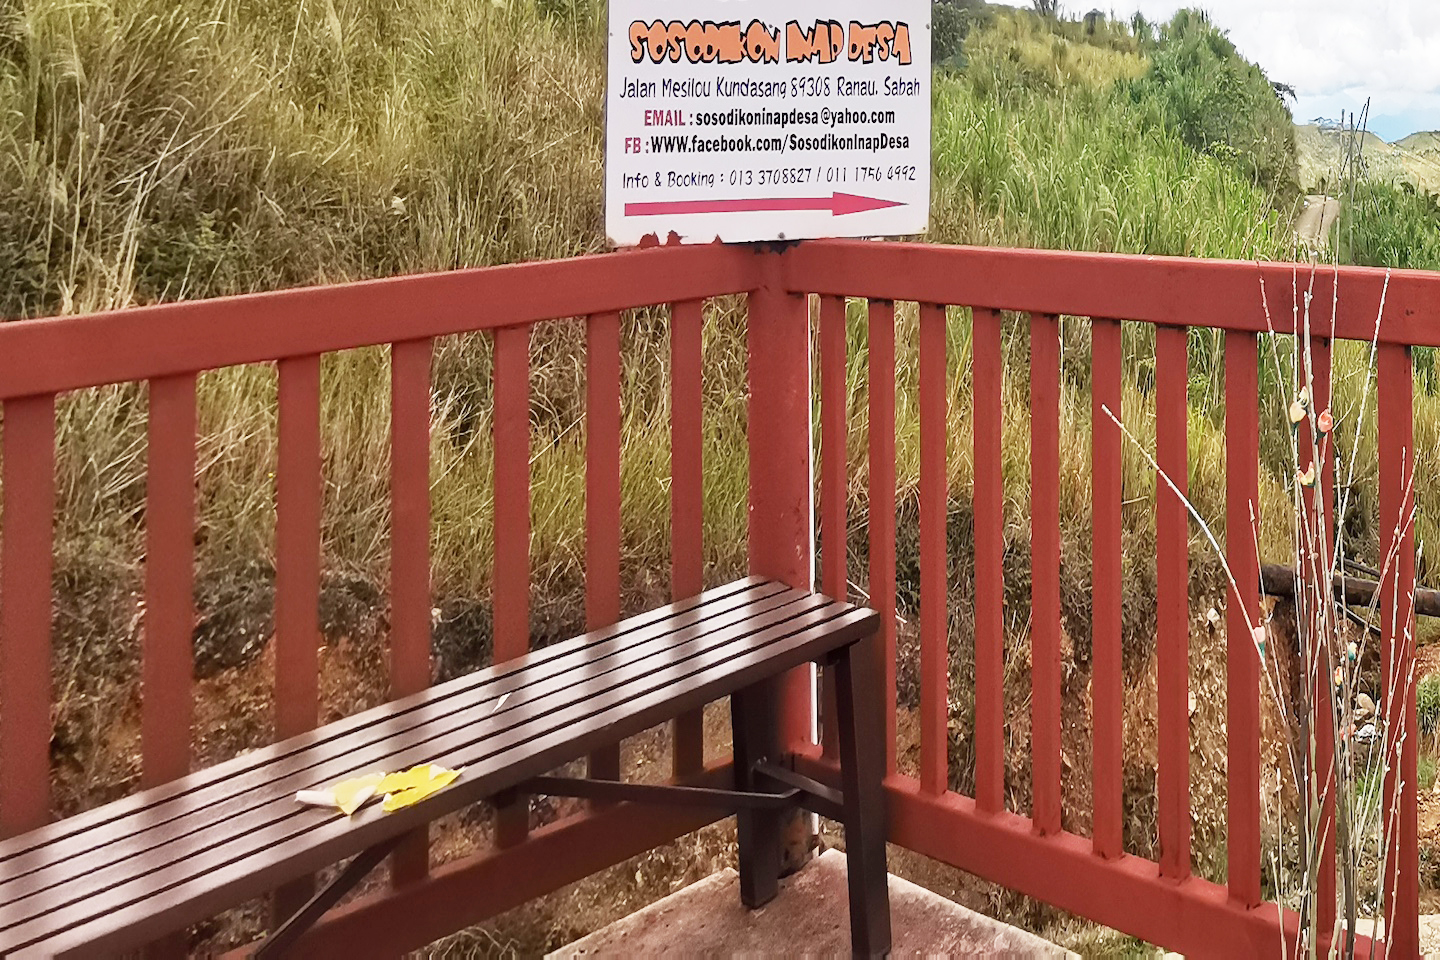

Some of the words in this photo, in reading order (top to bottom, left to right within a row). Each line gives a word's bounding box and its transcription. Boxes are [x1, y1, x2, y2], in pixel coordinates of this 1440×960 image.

[847, 20, 912, 66] DESA
[620, 76, 656, 98] Jalan
[716, 76, 787, 99] Kundasang
[790, 76, 831, 97] 89308
[884, 75, 920, 96] Sabah
[622, 172, 649, 189] Info
[654, 171, 662, 187] &
[667, 171, 715, 188] Booking
[729, 169, 753, 186] 013
[757, 168, 812, 185] 3708827
[826, 166, 847, 182] 011
